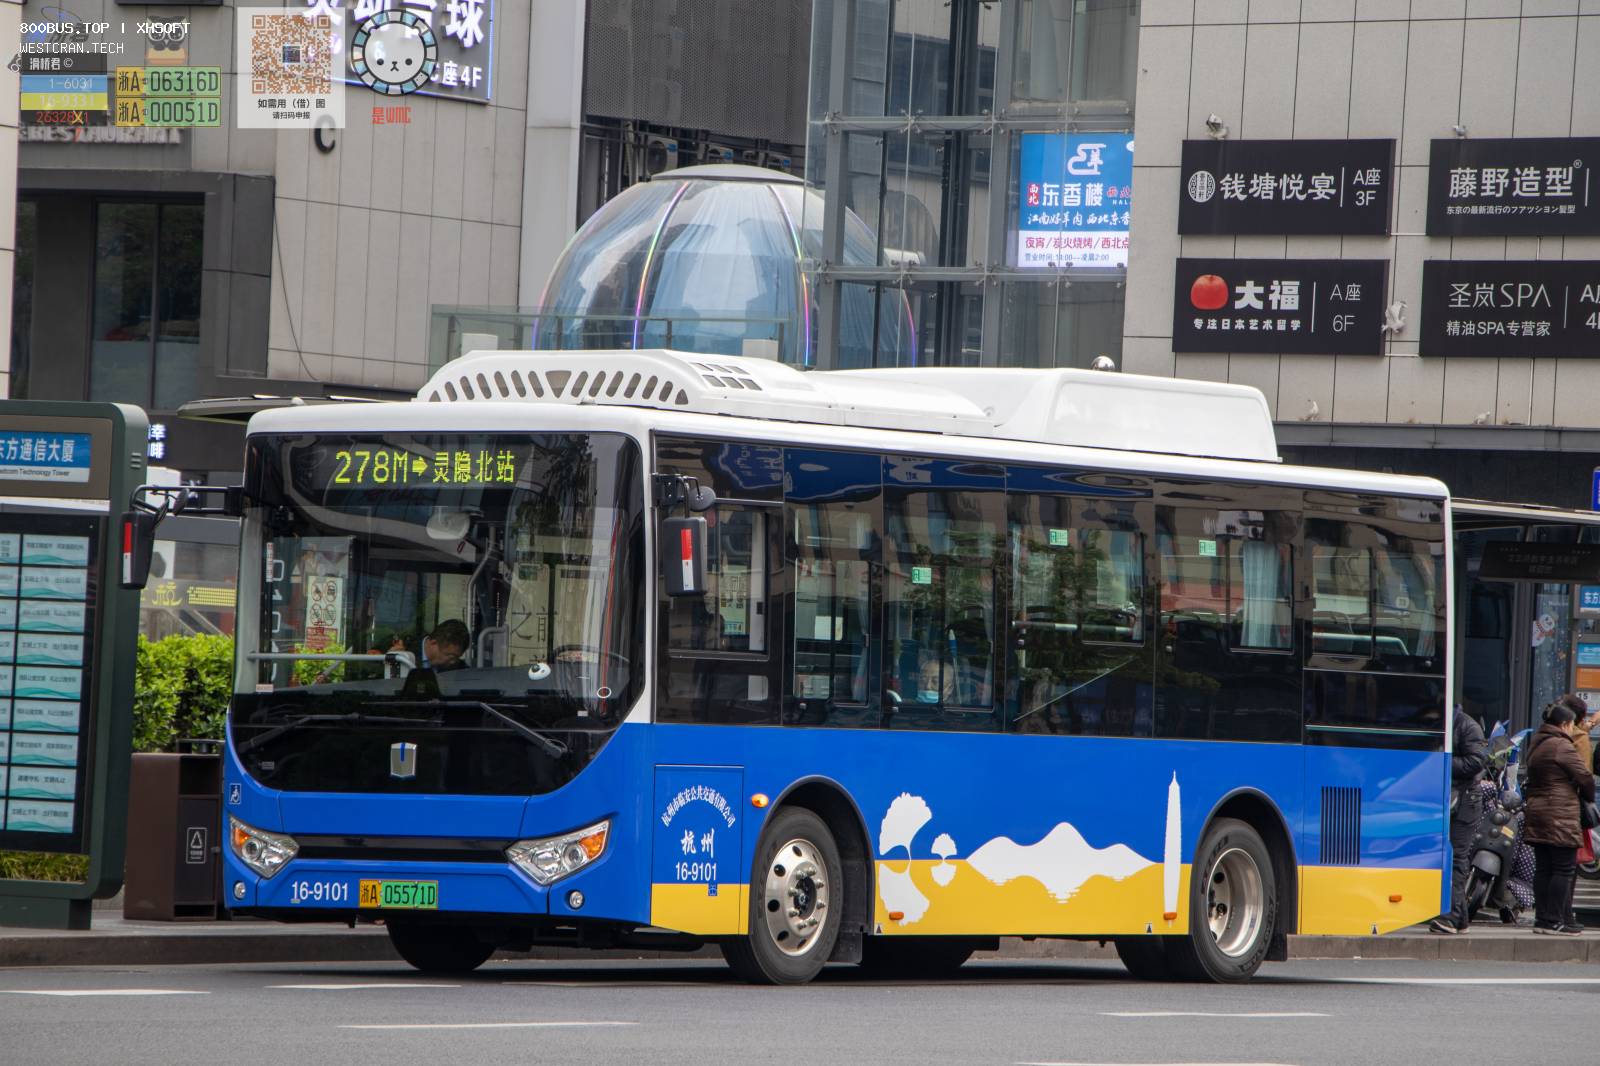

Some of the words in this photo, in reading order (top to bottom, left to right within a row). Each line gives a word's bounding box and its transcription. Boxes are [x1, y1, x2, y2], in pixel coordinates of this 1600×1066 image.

[1220, 172, 1336, 201] 钱塘悦宴
[1352, 167, 1381, 186] A座
[1449, 166, 1572, 198] 藤野造型
[1042, 182, 1104, 207] 东香楼
[1355, 190, 1377, 206] 3F
[1234, 280, 1300, 310] 大福
[1329, 282, 1361, 301] A座
[1193, 318, 1301, 331] 专注日本艺术留学
[1332, 315, 1356, 332] 6F
[148, 424, 166, 440] 幸
[335, 451, 408, 483] 278M
[433, 451, 515, 483] 灵隐北站
[681, 828, 715, 859] 杭州
[675, 861, 717, 881] 16-9101
[291, 881, 349, 901] 16-9101
